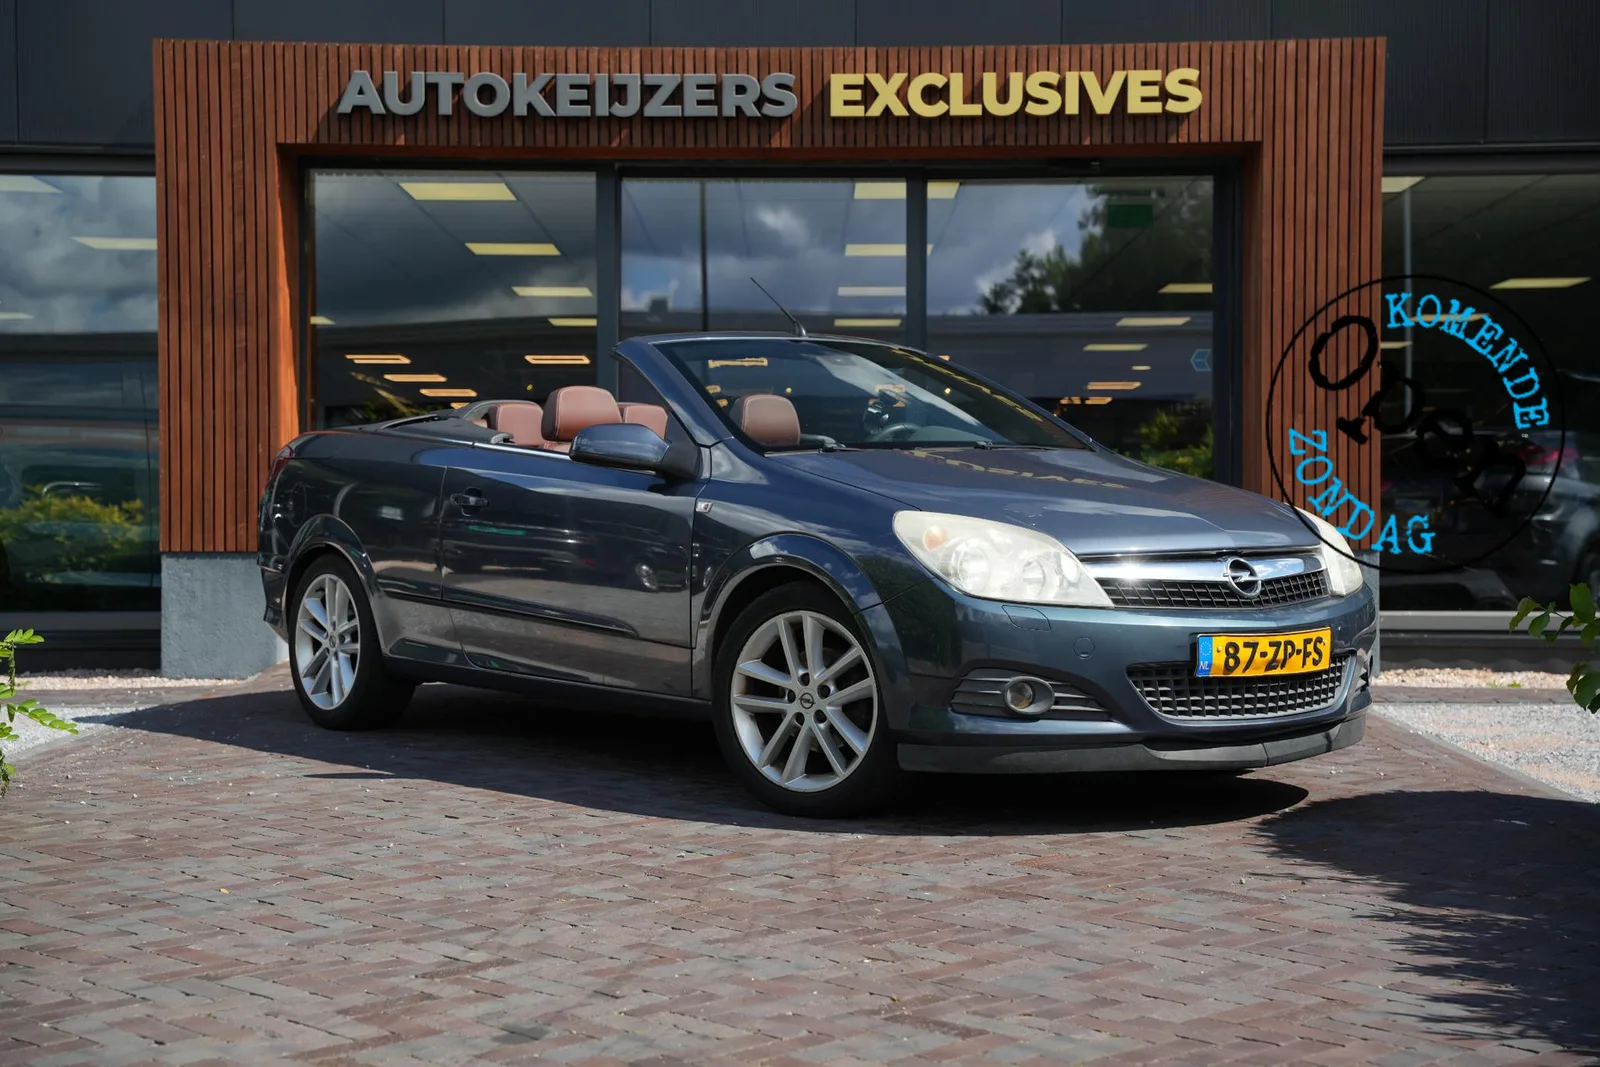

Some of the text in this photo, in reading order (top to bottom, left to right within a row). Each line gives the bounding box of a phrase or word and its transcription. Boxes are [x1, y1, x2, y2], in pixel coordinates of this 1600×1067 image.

[336, 67, 1203, 118] AUTOKEIJZERS EXCLUSIVES
[1199, 636, 1324, 673] NL 87-ZP-FS
